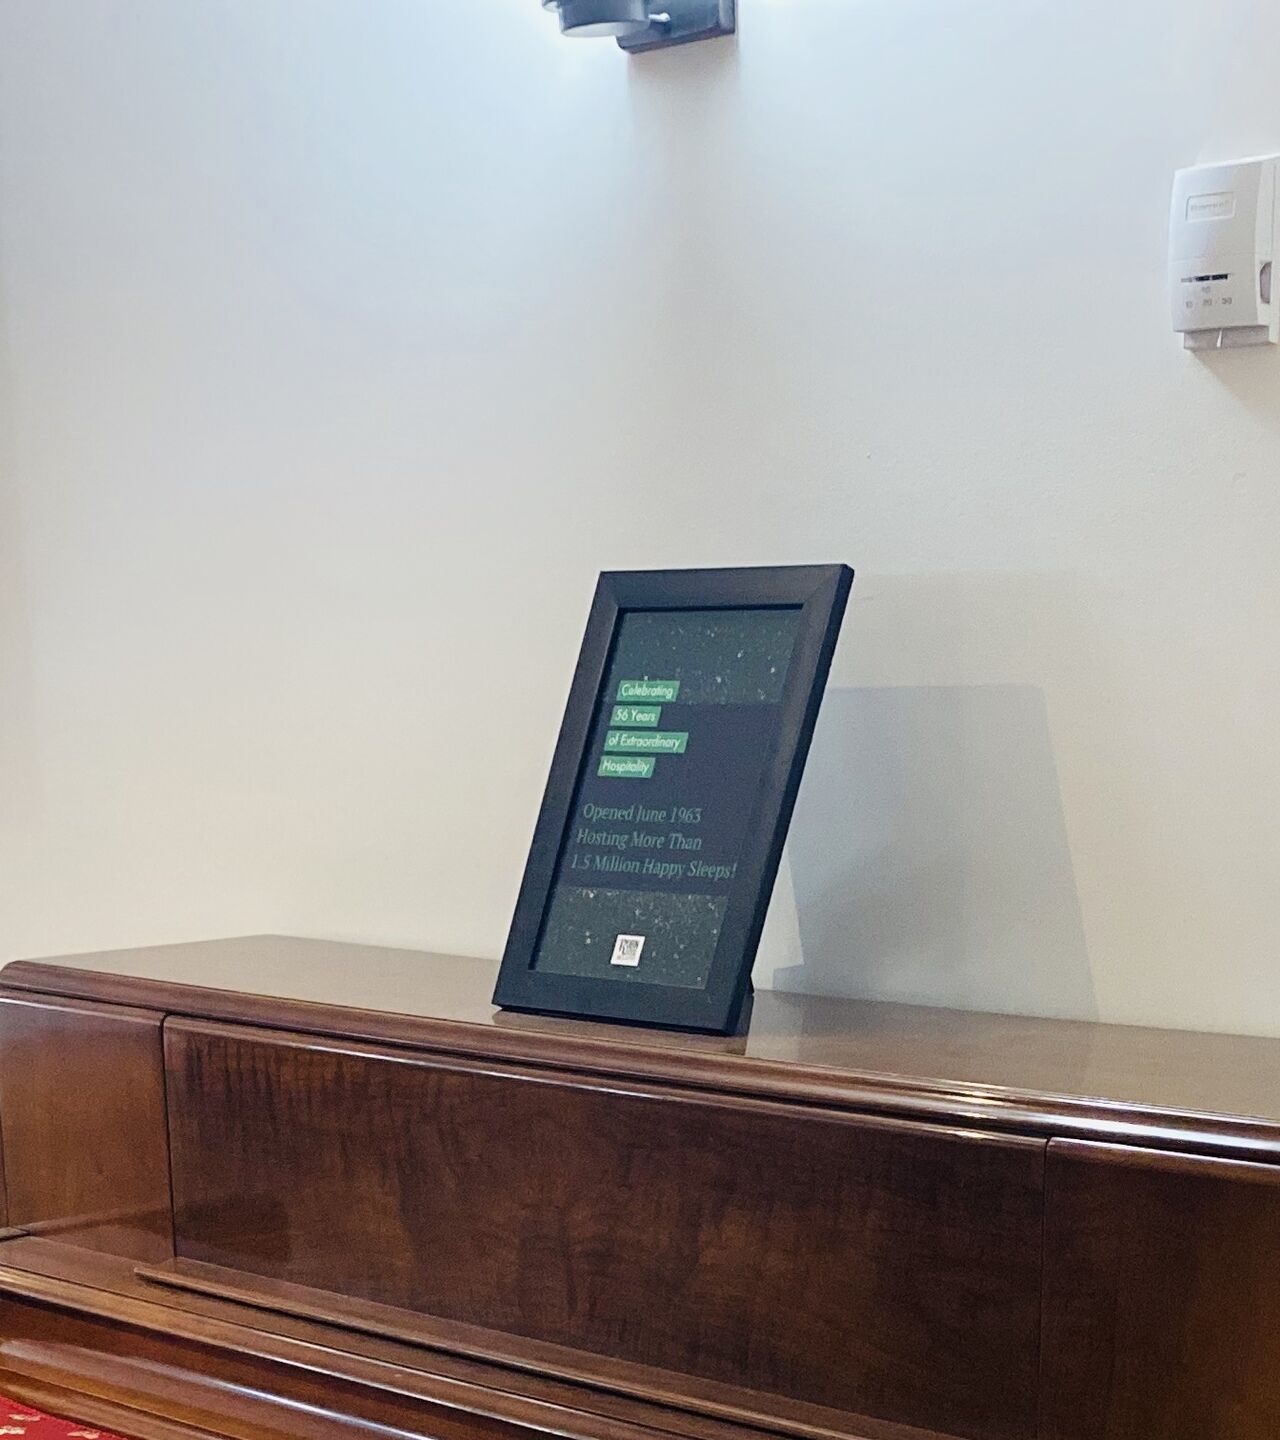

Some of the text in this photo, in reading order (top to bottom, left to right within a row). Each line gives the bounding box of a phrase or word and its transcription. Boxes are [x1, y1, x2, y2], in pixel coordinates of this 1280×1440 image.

[621, 683, 674, 700] Celebrating
[630, 708, 656, 722] Years
[608, 733, 680, 751] of Extraordinary
[602, 759, 650, 775] Hospitality
[583, 803, 703, 824] Opened June 1963
[576, 828, 703, 850] Hosting More Than
[571, 853, 739, 882] 1.5 Million Happy Sleeps!
